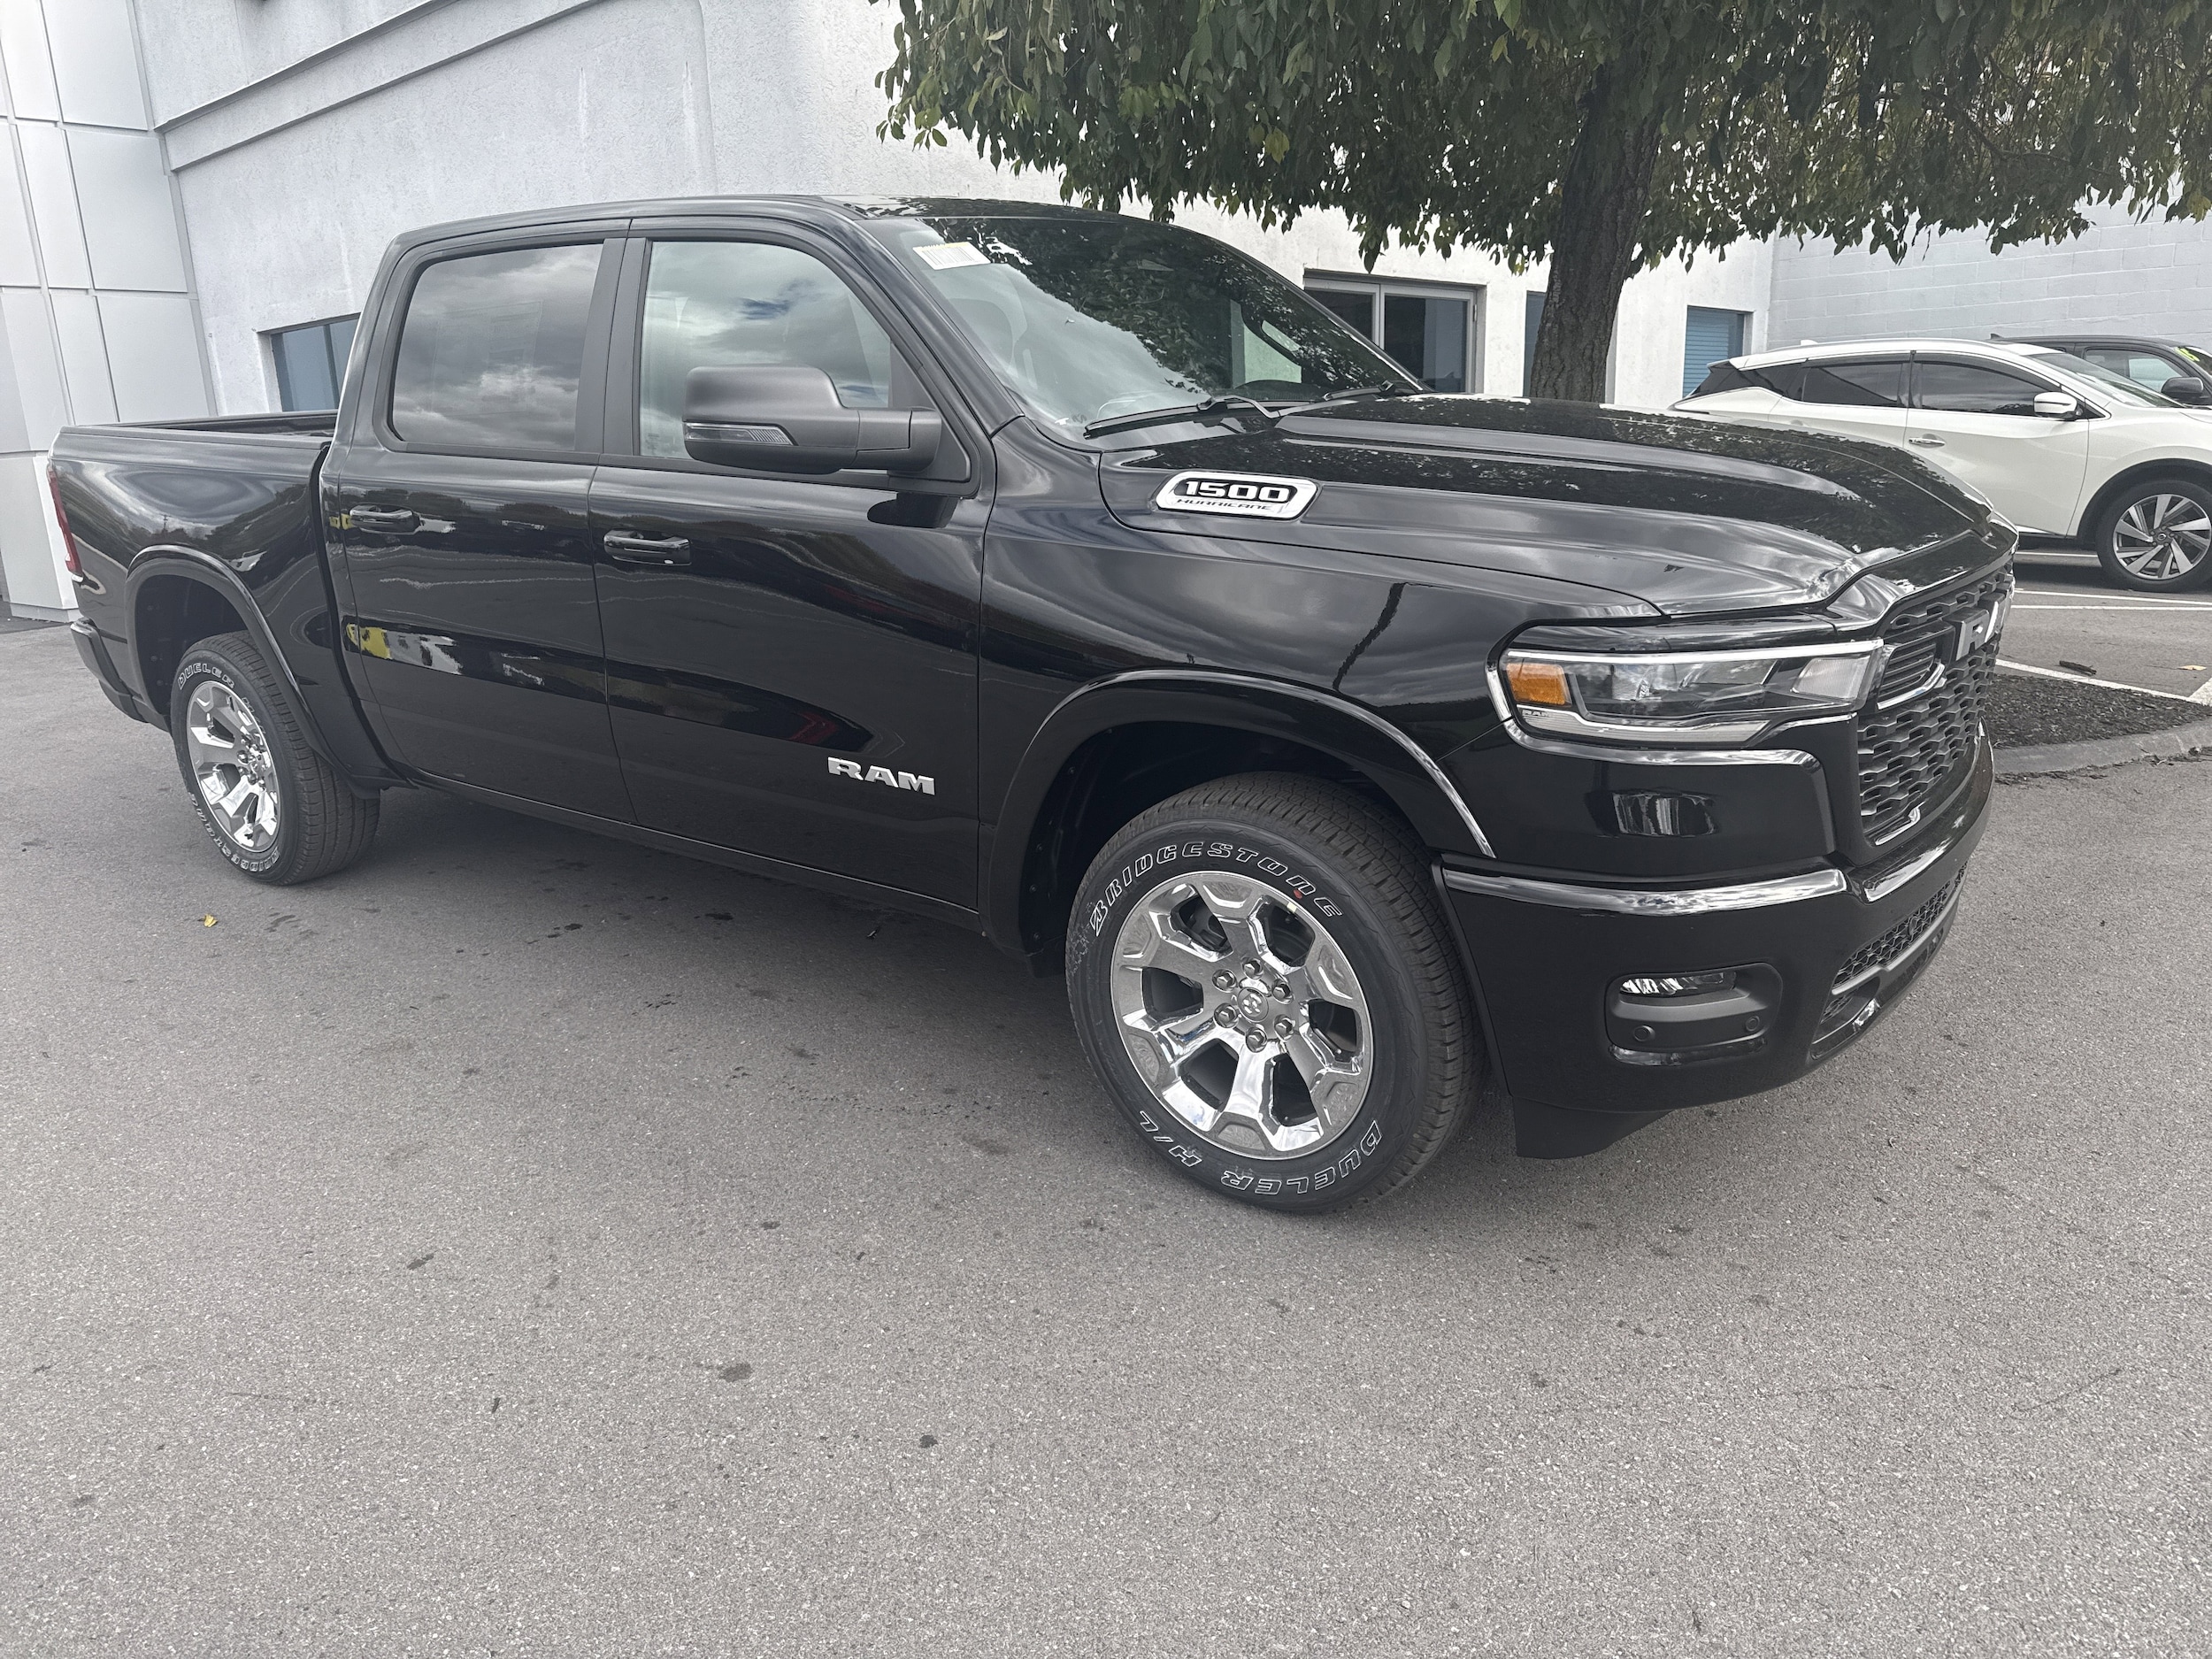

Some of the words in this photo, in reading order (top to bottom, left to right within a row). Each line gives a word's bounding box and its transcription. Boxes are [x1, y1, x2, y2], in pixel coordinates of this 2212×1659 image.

[1176, 498, 1273, 511] HURRICANE
[1186, 480, 1291, 503] 1500
[177, 662, 235, 690] DUELER
[827, 757, 935, 795] RAM
[1089, 841, 1342, 937] BRIDGESTONE
[1139, 1110, 1203, 1168] H/L
[1220, 1120, 1384, 1195] DUELER
